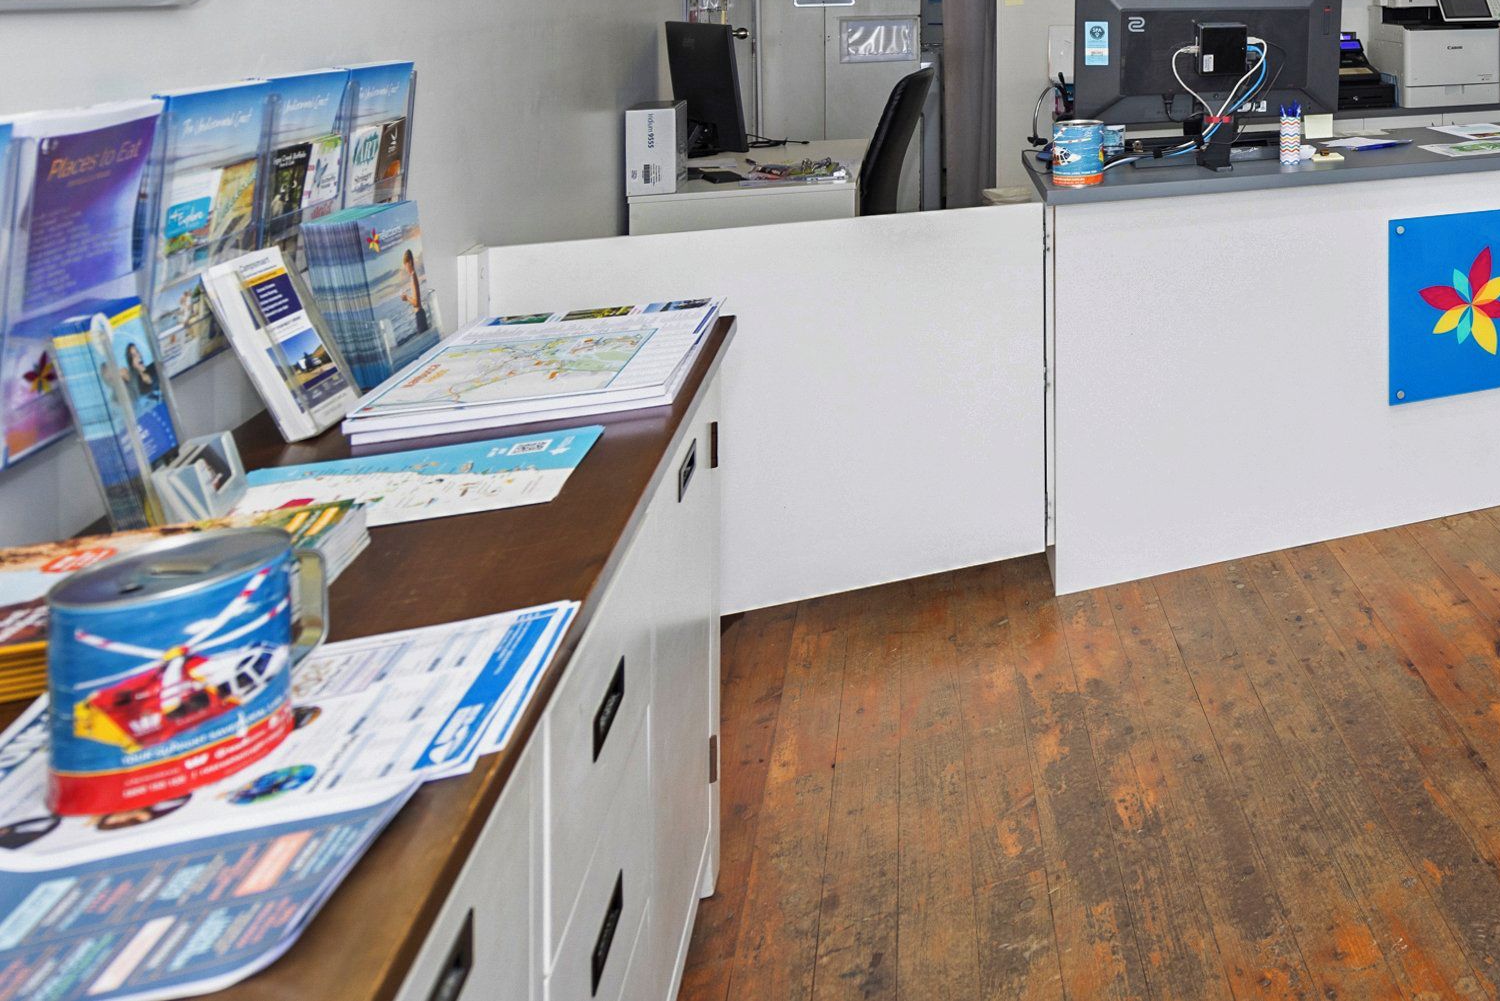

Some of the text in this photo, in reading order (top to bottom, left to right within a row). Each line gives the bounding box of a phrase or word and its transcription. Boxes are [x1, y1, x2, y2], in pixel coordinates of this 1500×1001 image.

[47, 138, 142, 182] Places to Eat
